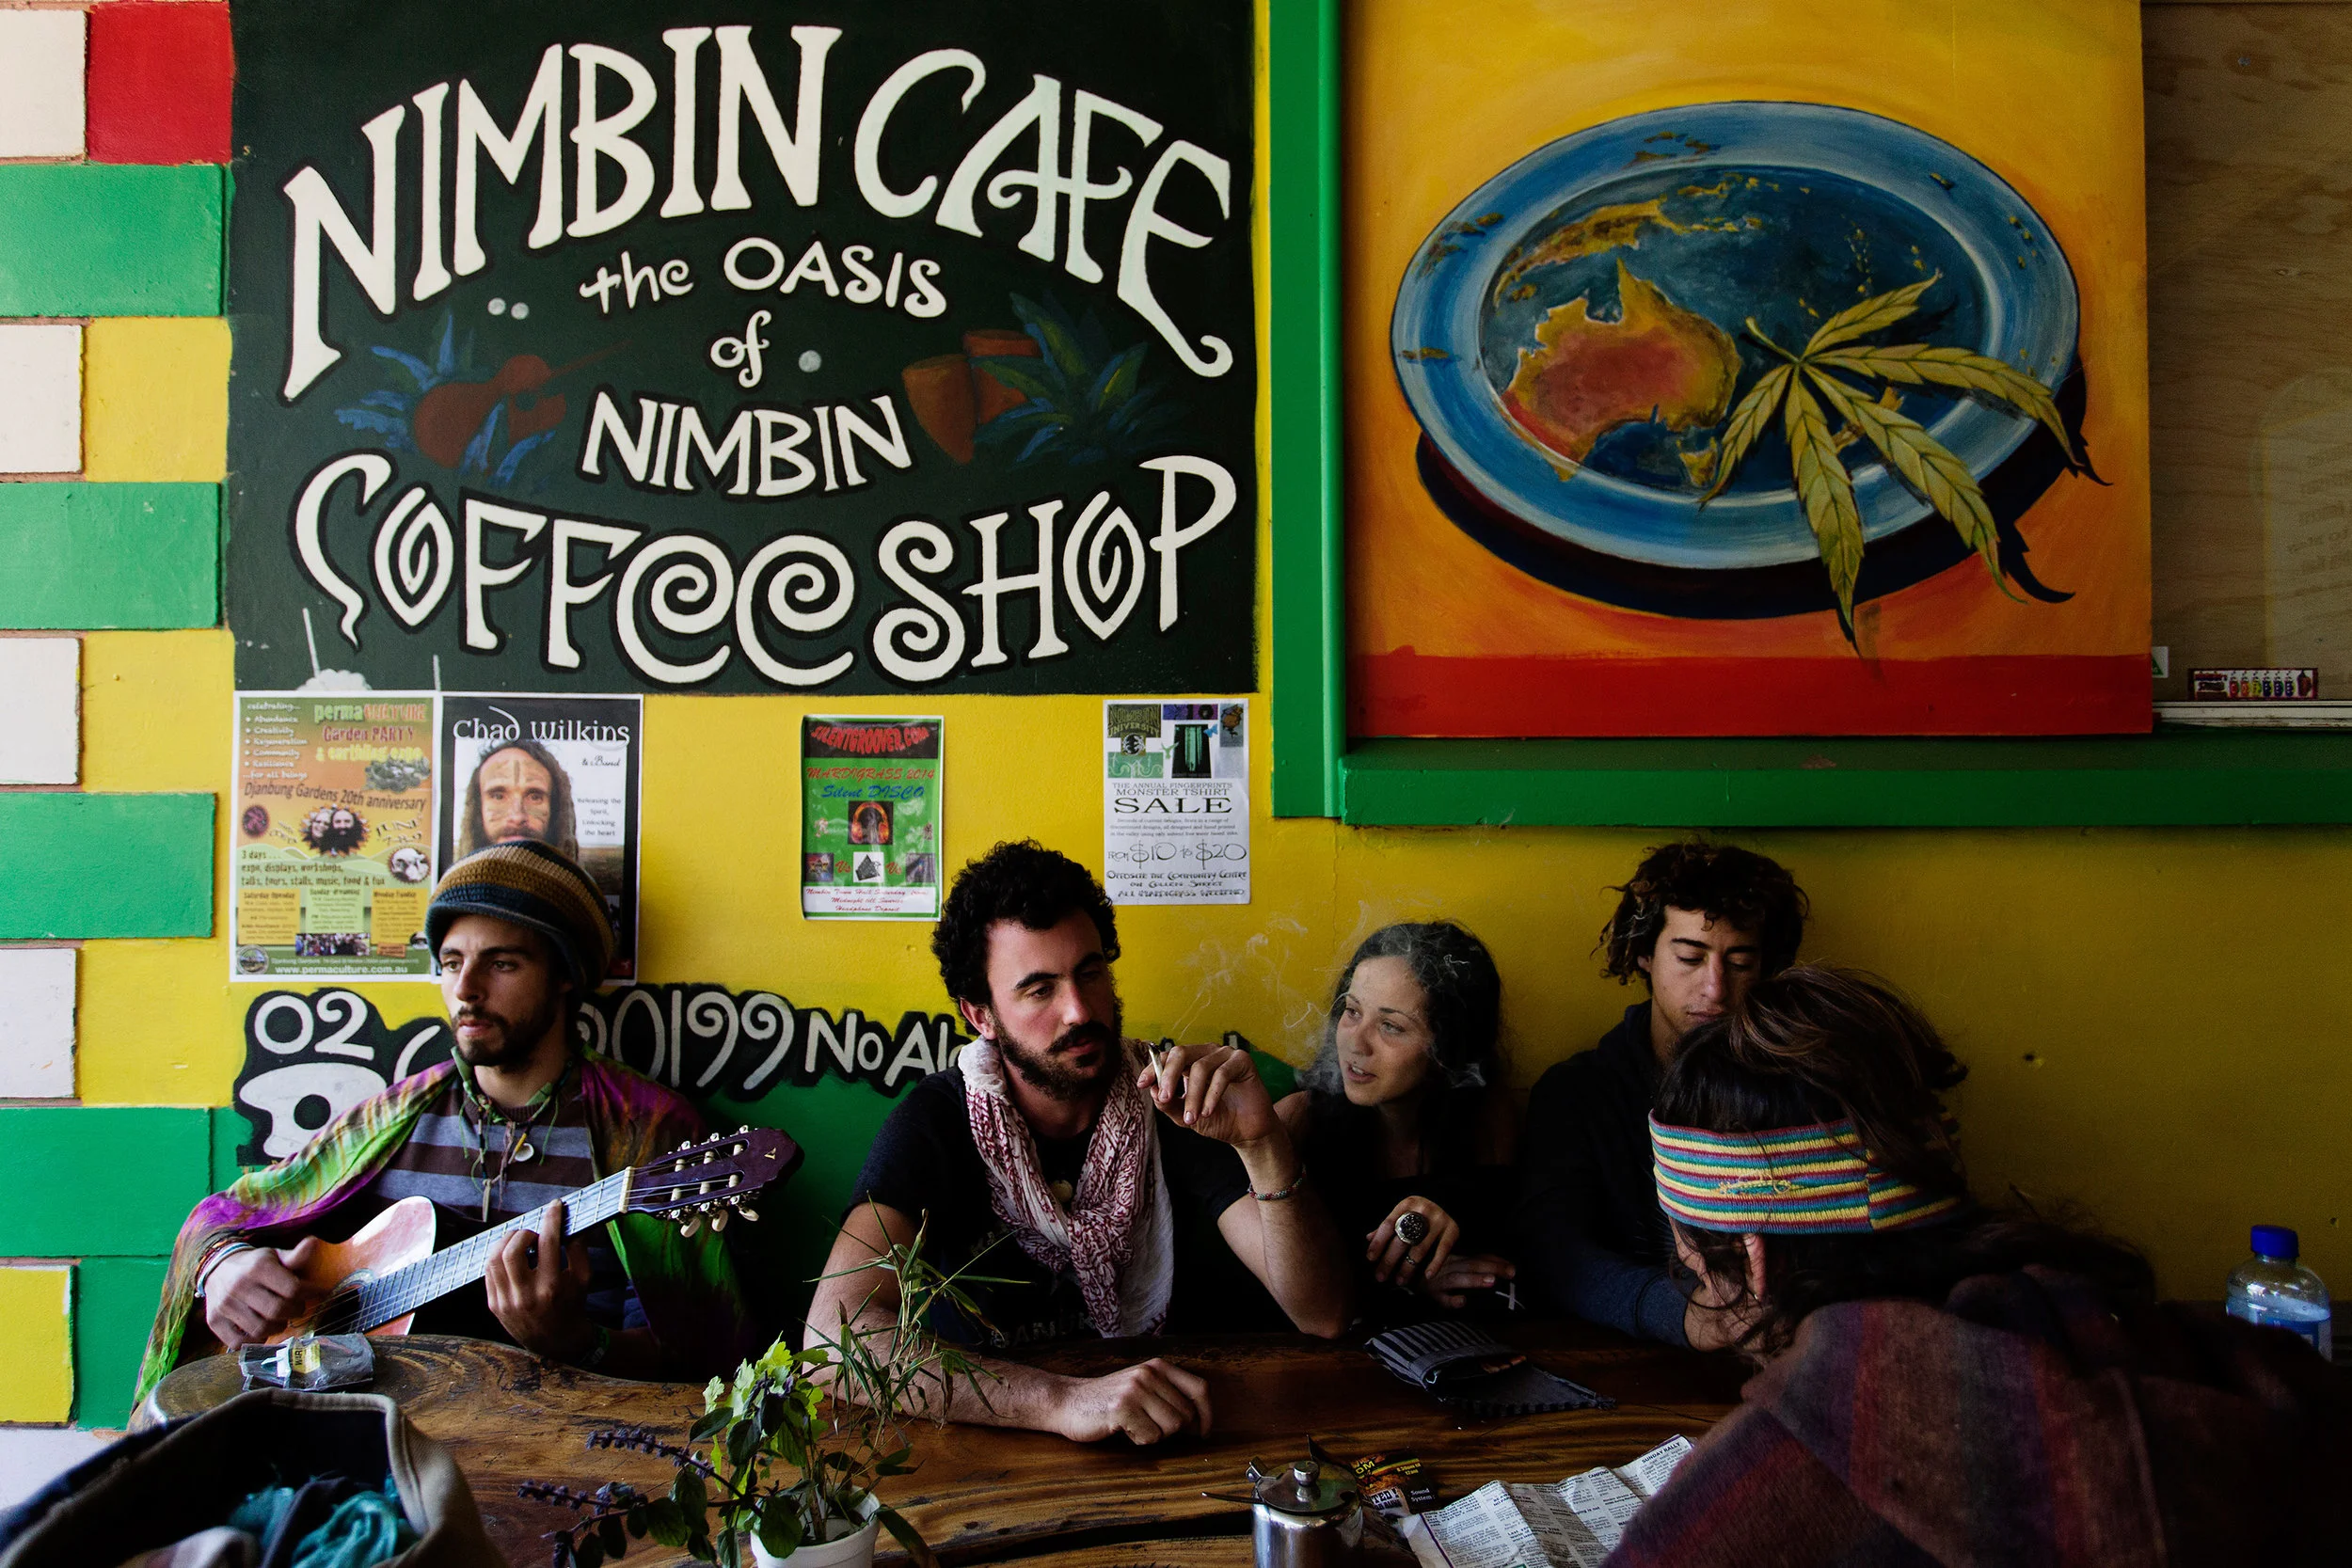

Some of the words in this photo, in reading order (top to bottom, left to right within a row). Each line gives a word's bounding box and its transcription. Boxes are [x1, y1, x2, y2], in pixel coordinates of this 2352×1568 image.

[282, 25, 842, 399] NIMBIN
[854, 49, 1233, 378] CAFE
[580, 251, 694, 313] the
[723, 237, 946, 317] OASIS
[710, 310, 771, 388] of
[581, 391, 912, 496] NIMBIN
[872, 455, 1236, 682] SHOP
[323, 724, 369, 742] Garden
[371, 724, 414, 742] PARTY
[453, 705, 521, 742] Chad
[531, 720, 630, 751] Wilkins
[806, 767, 903, 784] MARDIGRASS
[906, 768, 935, 781] 2014
[821, 784, 863, 799] Silent
[867, 784, 925, 800] DISCO
[296, 783, 339, 801] Gardens
[340, 788, 365, 806] 20th
[366, 793, 426, 812] anniversary
[1114, 798, 1232, 814] SALE
[1129, 839, 1177, 870] $10
[1195, 838, 1248, 871] $20
[804, 1012, 883, 1073] No
[1642, 1449, 1663, 1464] SUNDAY
[1663, 1441, 1680, 1453] RALLY
[1410, 1487, 1430, 1497] Sound
